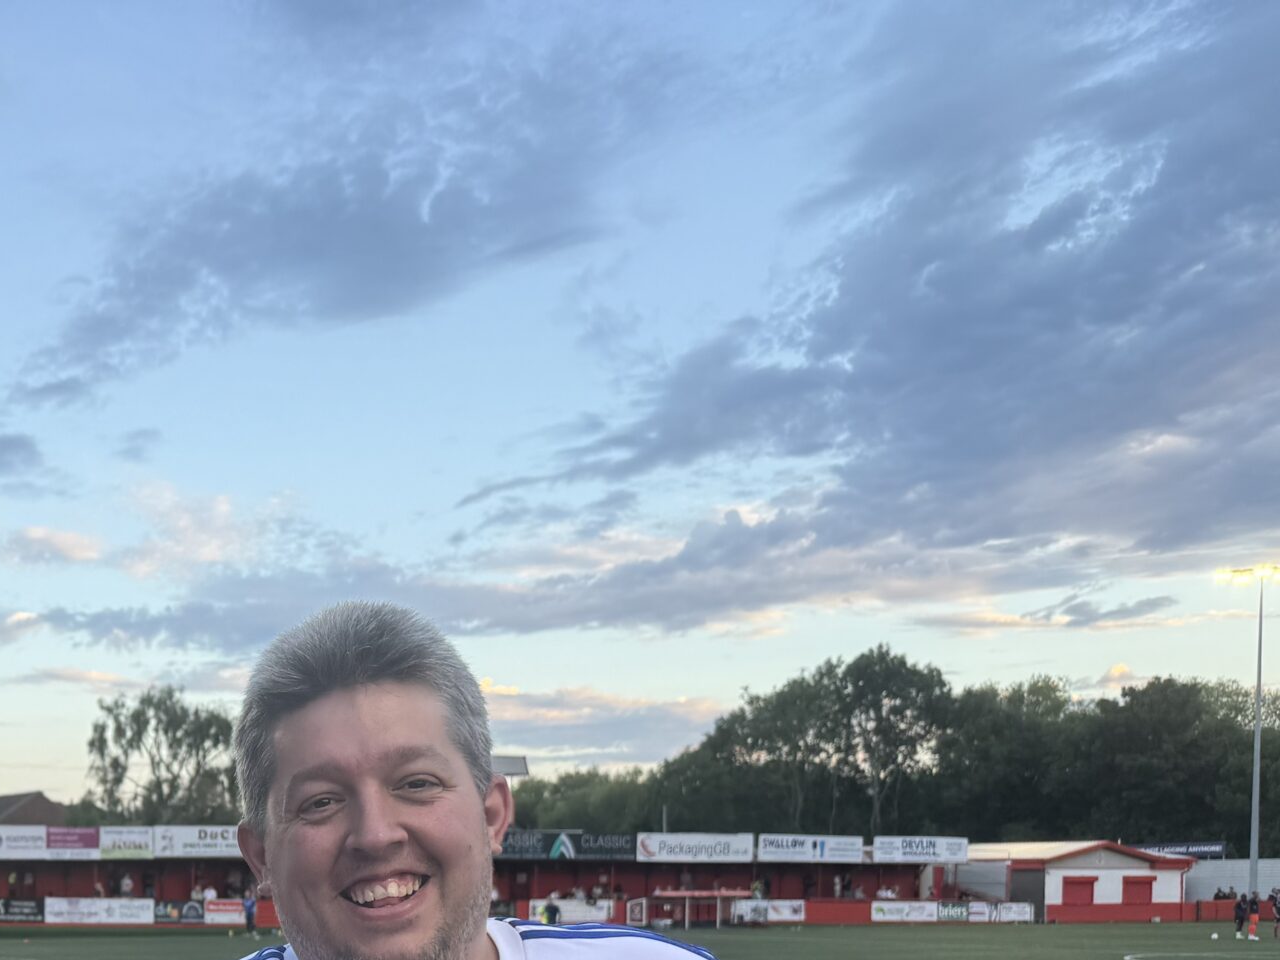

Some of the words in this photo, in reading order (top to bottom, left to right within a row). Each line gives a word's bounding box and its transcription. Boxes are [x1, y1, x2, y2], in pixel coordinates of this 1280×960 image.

[581, 834, 631, 848] CLASSIC
[762, 838, 805, 850] SWALLOW
[902, 839, 936, 850] DEVLIN
[938, 902, 968, 918] briers
